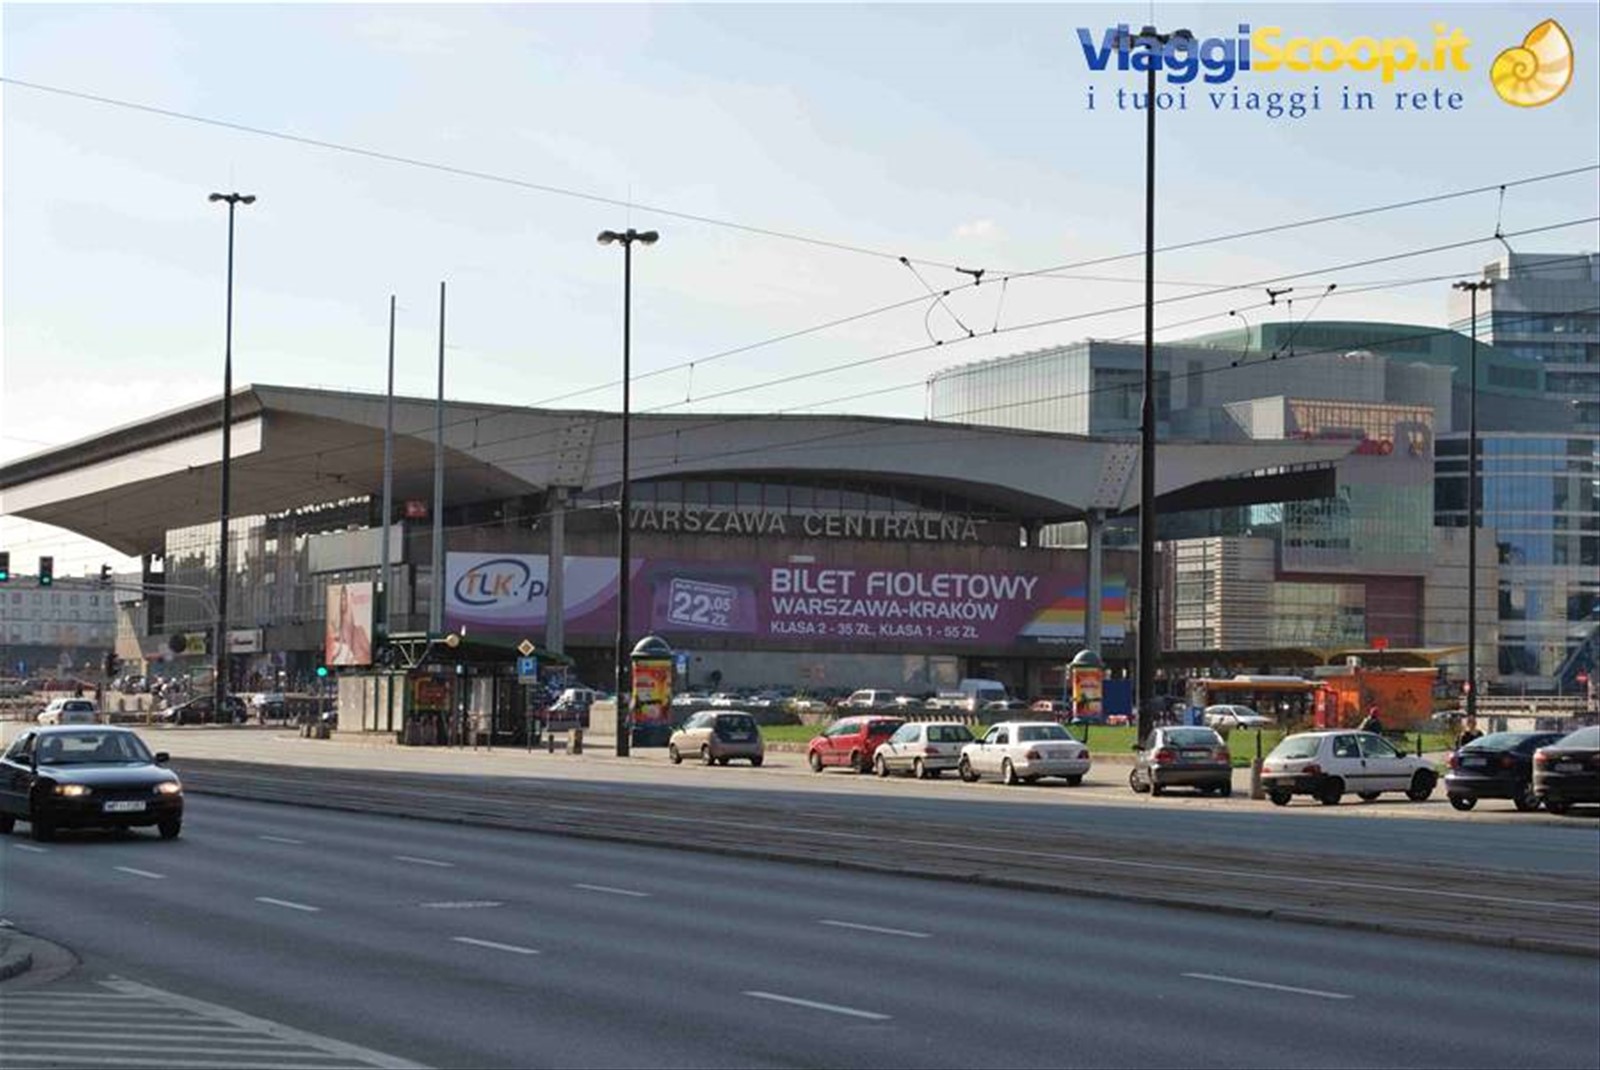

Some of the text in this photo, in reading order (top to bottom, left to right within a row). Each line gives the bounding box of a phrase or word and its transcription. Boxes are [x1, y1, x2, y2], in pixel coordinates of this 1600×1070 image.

[803, 512, 979, 541] CENTRALNA
[771, 568, 1039, 600] BILET FIOLETOWY
[771, 597, 999, 620] WARSZAWA-KRAKÓW
[770, 621, 815, 635] KLASA
[818, 623, 826, 635] 2
[838, 623, 853, 636] 35
[879, 624, 924, 637] KLASA
[926, 625, 932, 636] 1
